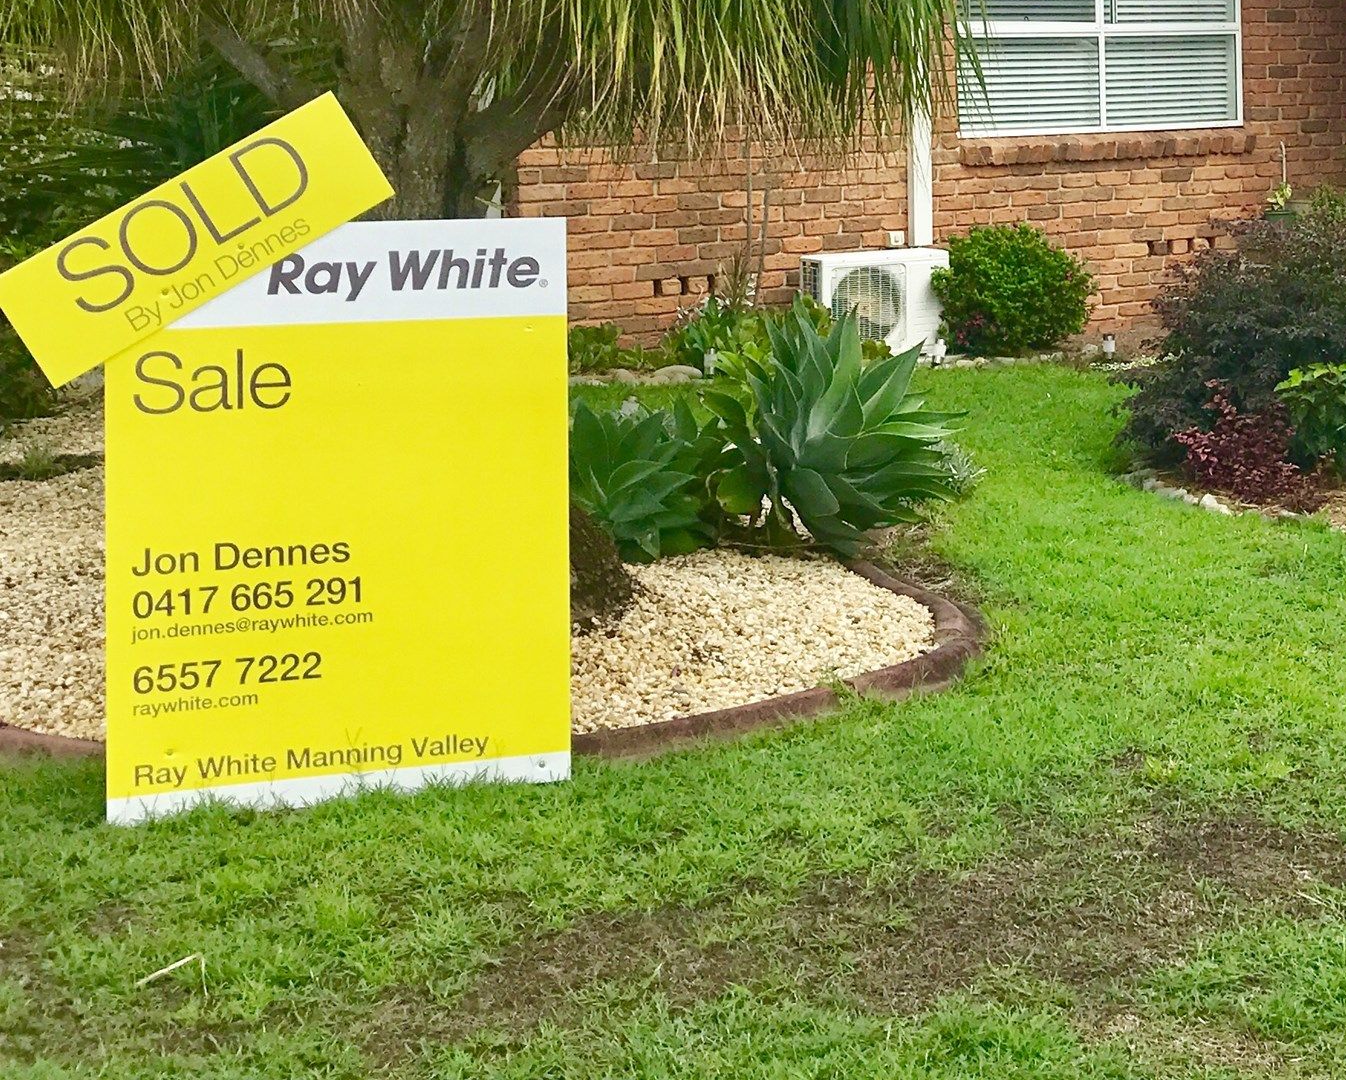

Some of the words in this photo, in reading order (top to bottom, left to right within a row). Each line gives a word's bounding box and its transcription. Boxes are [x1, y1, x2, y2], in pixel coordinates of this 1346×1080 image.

[57, 136, 309, 313] SOLD
[124, 304, 163, 334] By
[220, 217, 312, 281] Dennes
[267, 253, 377, 302] Ray
[133, 349, 292, 414] Sale
[131, 547, 199, 577] Jon
[214, 541, 351, 572] Dennes
[132, 586, 219, 619] 0417
[231, 581, 295, 612] 665
[306, 576, 362, 606] 291
[131, 609, 373, 644] jon.dennes@raywhite.com
[133, 660, 222, 694] 6557
[236, 651, 322, 685] 7222
[132, 692, 259, 717] raywhite.com
[134, 760, 188, 787] Ray
[197, 753, 277, 779] White
[286, 740, 403, 770] Manning
[410, 733, 490, 758] Valley
